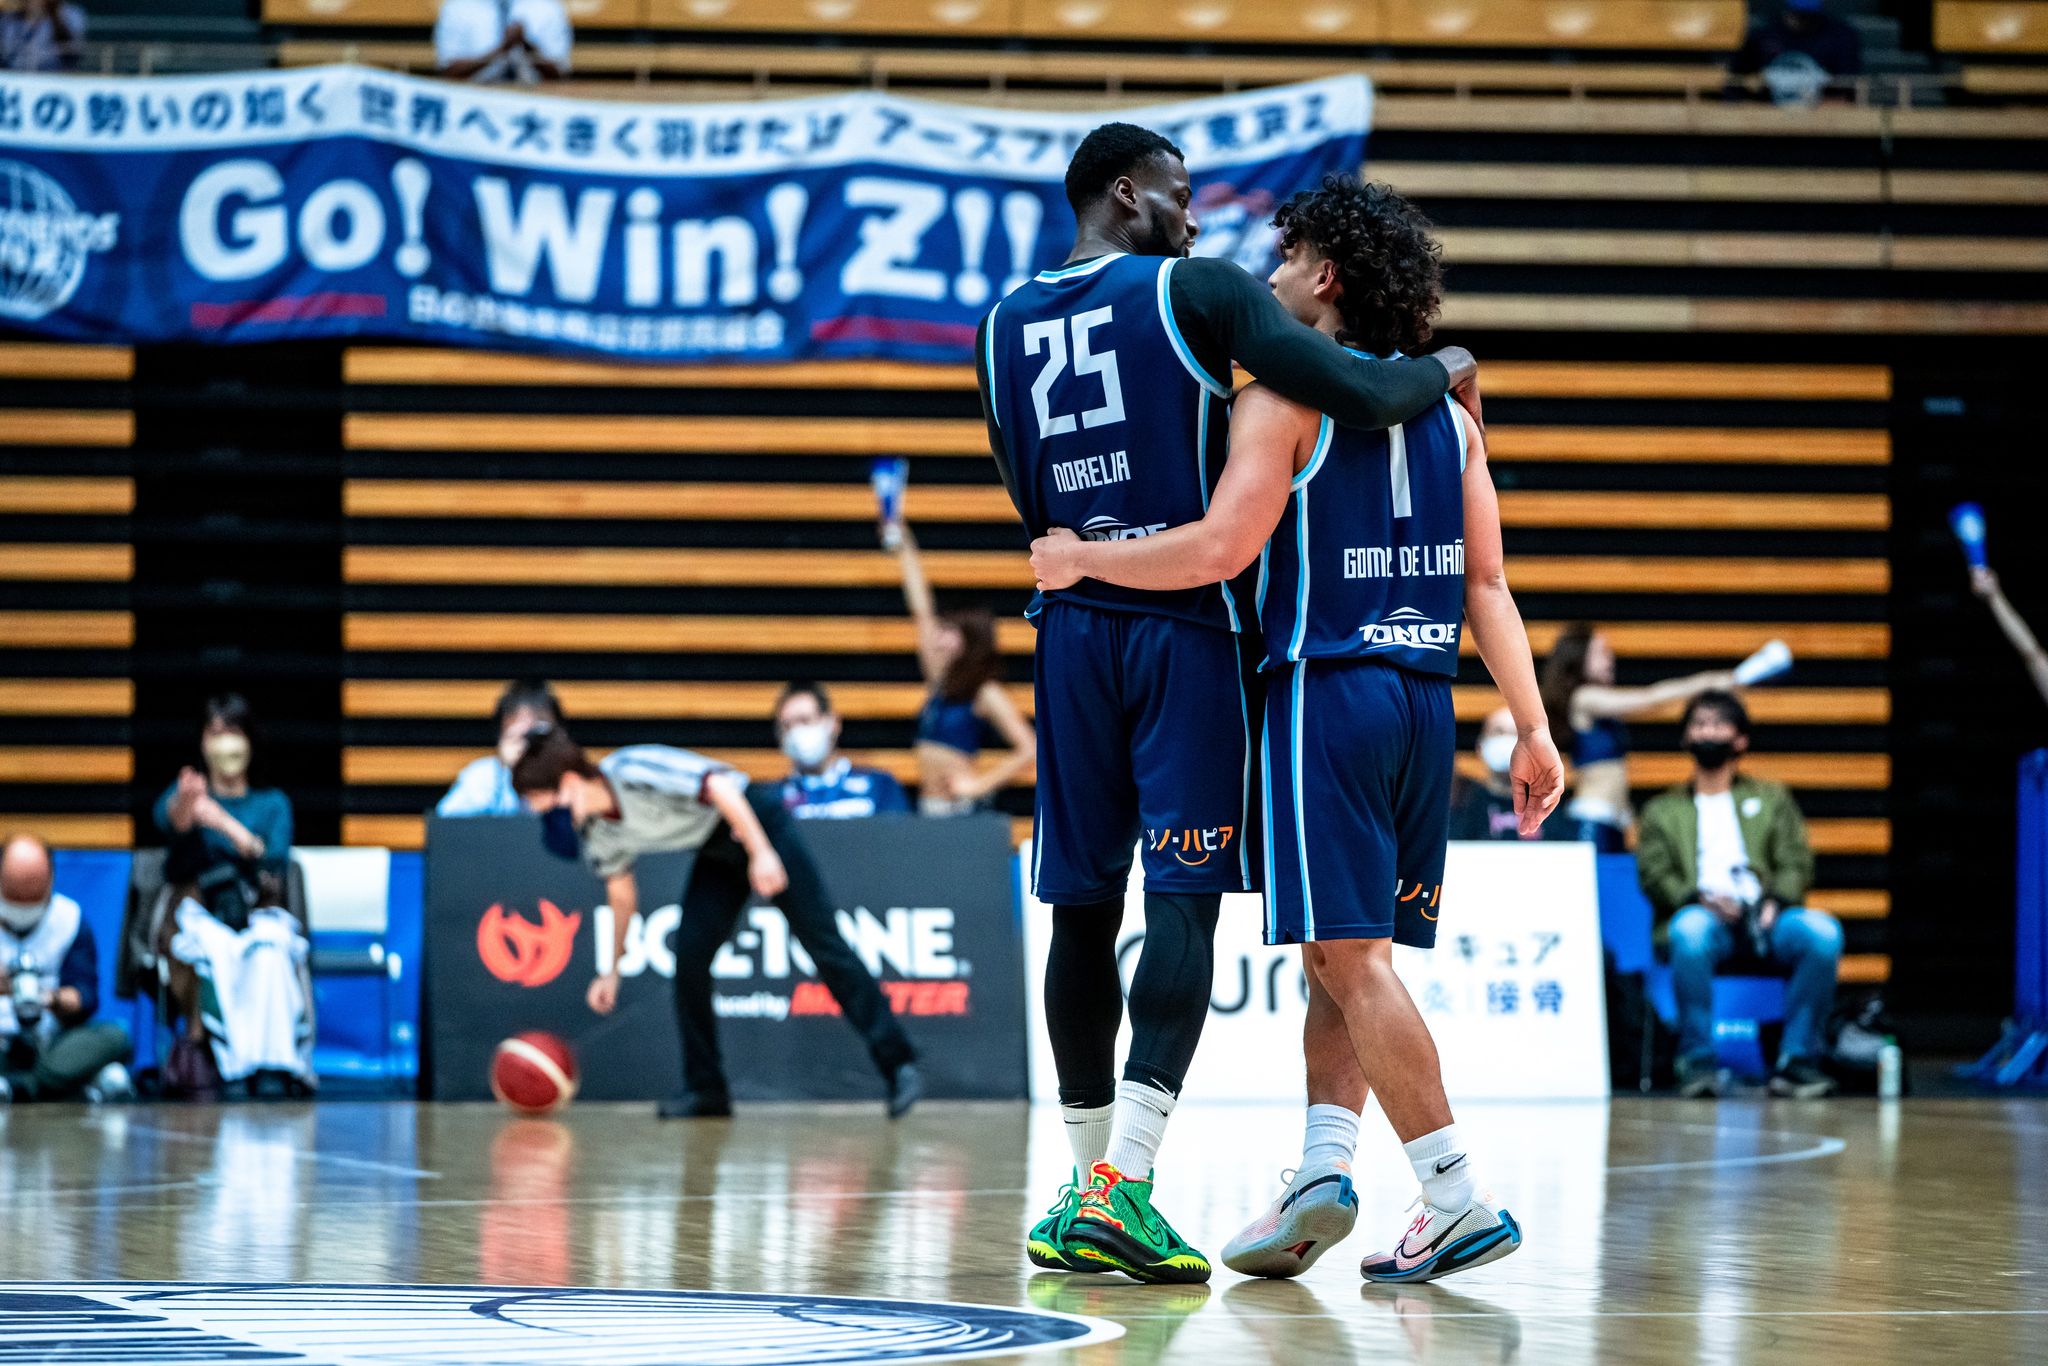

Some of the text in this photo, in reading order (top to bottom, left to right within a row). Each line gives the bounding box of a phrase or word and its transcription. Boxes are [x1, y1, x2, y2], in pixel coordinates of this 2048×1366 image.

[180, 158, 1044, 307] Go! Win! Z!!
[1023, 305, 1126, 439] 25
[1052, 450, 1131, 493] NORELIA
[1399, 545, 1420, 577] DE
[1358, 623, 1457, 644] TOMOE
